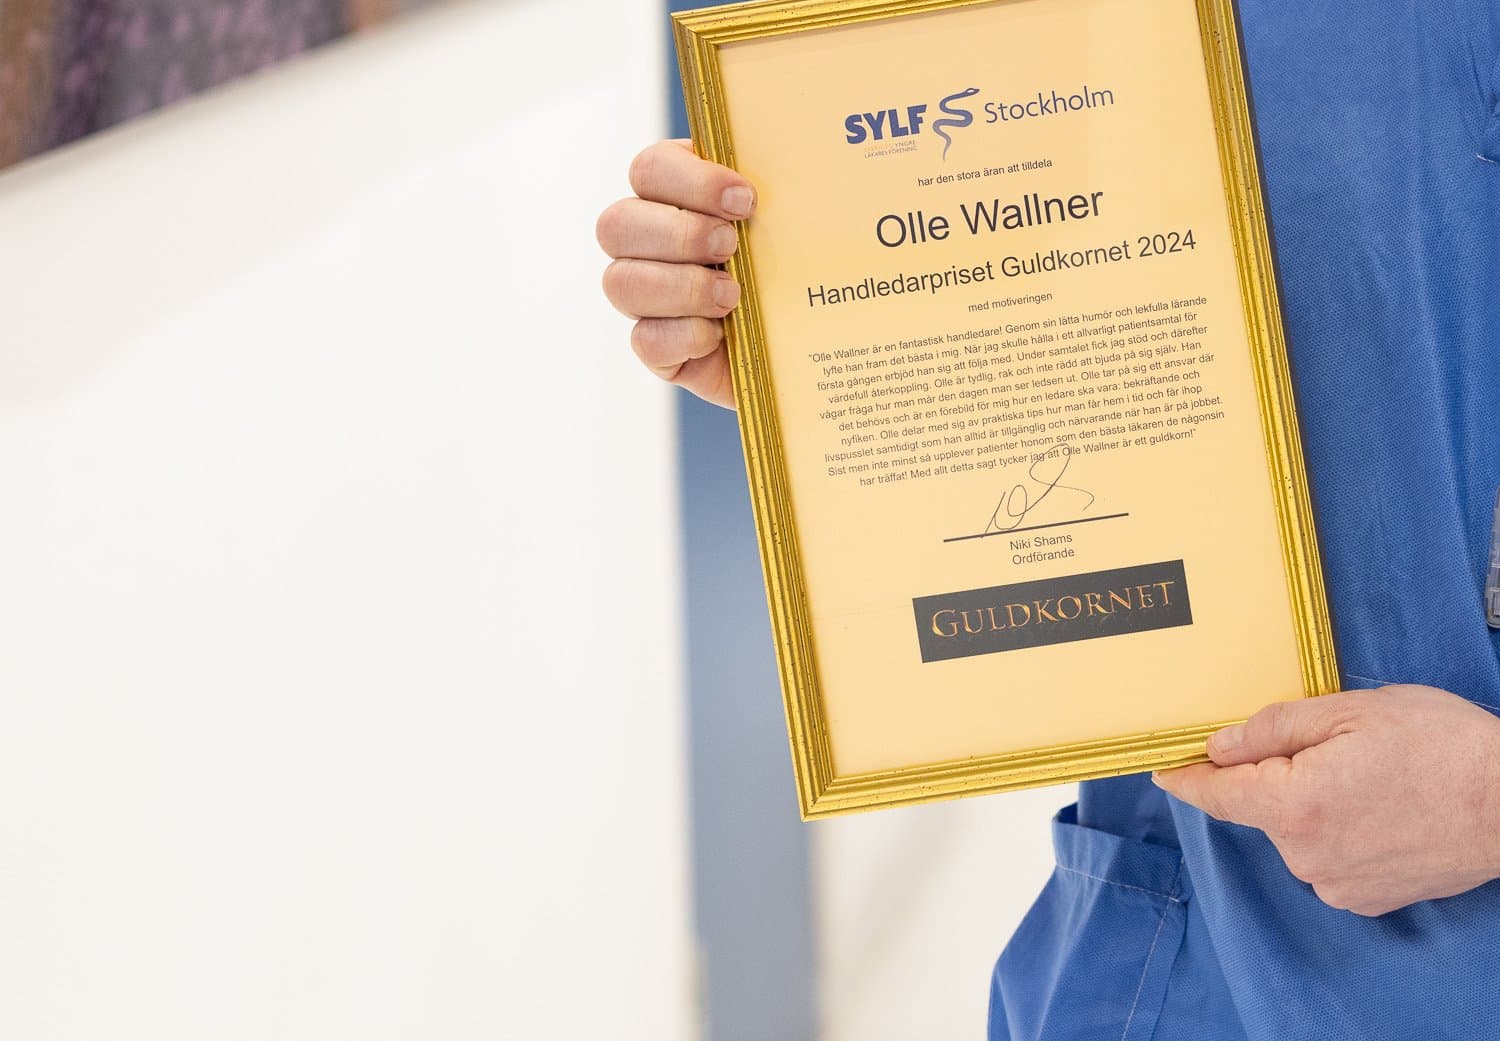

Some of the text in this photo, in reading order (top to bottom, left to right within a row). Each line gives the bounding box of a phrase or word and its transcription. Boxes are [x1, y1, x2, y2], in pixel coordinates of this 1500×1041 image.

[844, 85, 1114, 145] SYLF Stockholm
[917, 159, 1053, 187] har den stora äran att tilldela
[876, 191, 1104, 248] Olle Wallner
[807, 229, 1197, 308] Handledarpriset Guldkornet 2024
[833, 296, 1207, 359] Wallner fantastisk Genom sin lätta humör och lekfulla lärande
[968, 293, 1053, 312] med motiveringen
[817, 326, 1208, 391] första gången erbjöd han sig att följa Under samtalet fick jag stöd och därefter
[823, 311, 1198, 378] lyfte han fram det bästa När jag skulle hålla ett allvarligt patientsamtal för
[828, 342, 1202, 404] värdefull Olle rak och inte rädd att bjuda sig Han
[819, 353, 1214, 420] vågar fråga hur man mår den dagen man ser ledsen Olle tar sig ett ansvar där
[838, 421, 854, 431] det
[855, 417, 891, 429] behövs
[892, 413, 910, 423] och
[939, 403, 975, 416] förebild
[977, 401, 990, 411] för
[992, 398, 1010, 409] mig
[1012, 396, 1028, 406] hur
[1045, 390, 1075, 401] ledare
[1077, 386, 1095, 396] ska
[1123, 373, 1180, 389] bekräftande
[1182, 370, 1200, 380] och
[880, 429, 899, 440] Olle
[901, 426, 925, 437] delar
[928, 422, 949, 432] med
[951, 419, 966, 430] sig
[981, 411, 1025, 427] praktiska
[1026, 409, 1044, 419] tips
[1045, 406, 1062, 415] hur
[1064, 403, 1086, 412] man
[1087, 399, 1101, 409] får
[1103, 397, 1125, 407] hem
[1131, 392, 1144, 403] tid
[1146, 389, 1164, 400] och
[1166, 388, 1179, 397] får
[1181, 385, 1203, 395] ihop
[824, 448, 874, 463] livspusslet
[876, 441, 919, 455] samtidigt
[921, 439, 942, 448] som
[943, 435, 962, 445] han
[964, 430, 987, 442] alltid
[1001, 422, 1046, 437] tillgänglig
[1048, 419, 1066, 429] och
[1068, 411, 1122, 427] närvarande
[1124, 408, 1140, 418] när
[1142, 406, 1162, 415] han
[828, 410, 1225, 476] Sist men inte minst upplever patienter honom som den bästa läkaren någonsin
[859, 477, 875, 486] har
[910, 467, 932, 479] Med
[934, 465, 948, 475] allt
[950, 463, 974, 473] detta
[976, 458, 997, 470] sagt
[999, 455, 1028, 468] tycker
[1083, 441, 1120, 453] Wallner
[1134, 436, 1147, 446] ett
[1009, 534, 1073, 551] Niki Shams
[1012, 547, 1075, 565] Ordförande
[931, 579, 1176, 639] GULDKORNET
